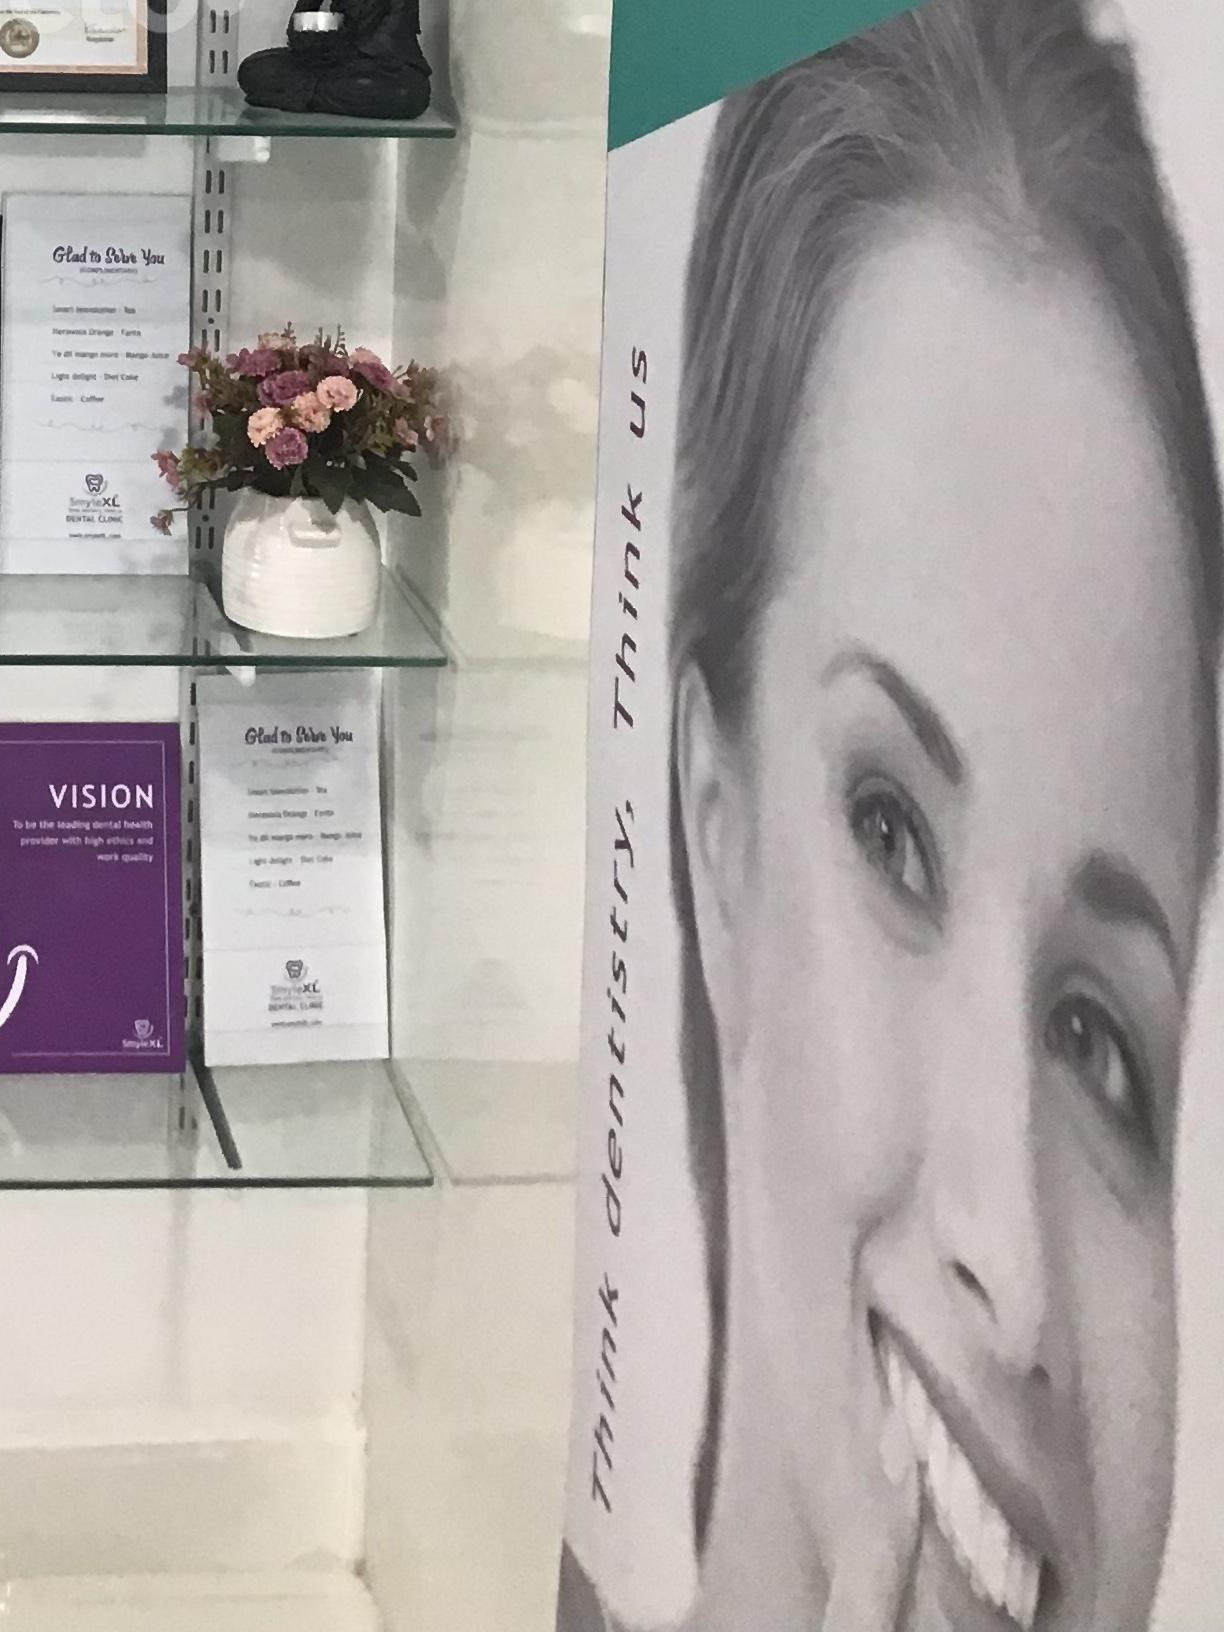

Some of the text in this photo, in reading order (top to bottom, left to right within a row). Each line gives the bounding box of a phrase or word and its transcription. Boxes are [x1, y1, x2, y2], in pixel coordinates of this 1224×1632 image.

[53, 246, 88, 263] Glad
[90, 250, 101, 263] to
[141, 249, 165, 265] You
[245, 726, 278, 744] Glad
[281, 730, 292, 743] to
[330, 726, 353, 744] You
[49, 784, 153, 808] VISION
[13, 820, 152, 830] To be the leading dental health
[20, 836, 154, 847] provider with high ethics and
[96, 853, 153, 862] work quality
[591, 345, 649, 1513] Think dentistry, Think us
